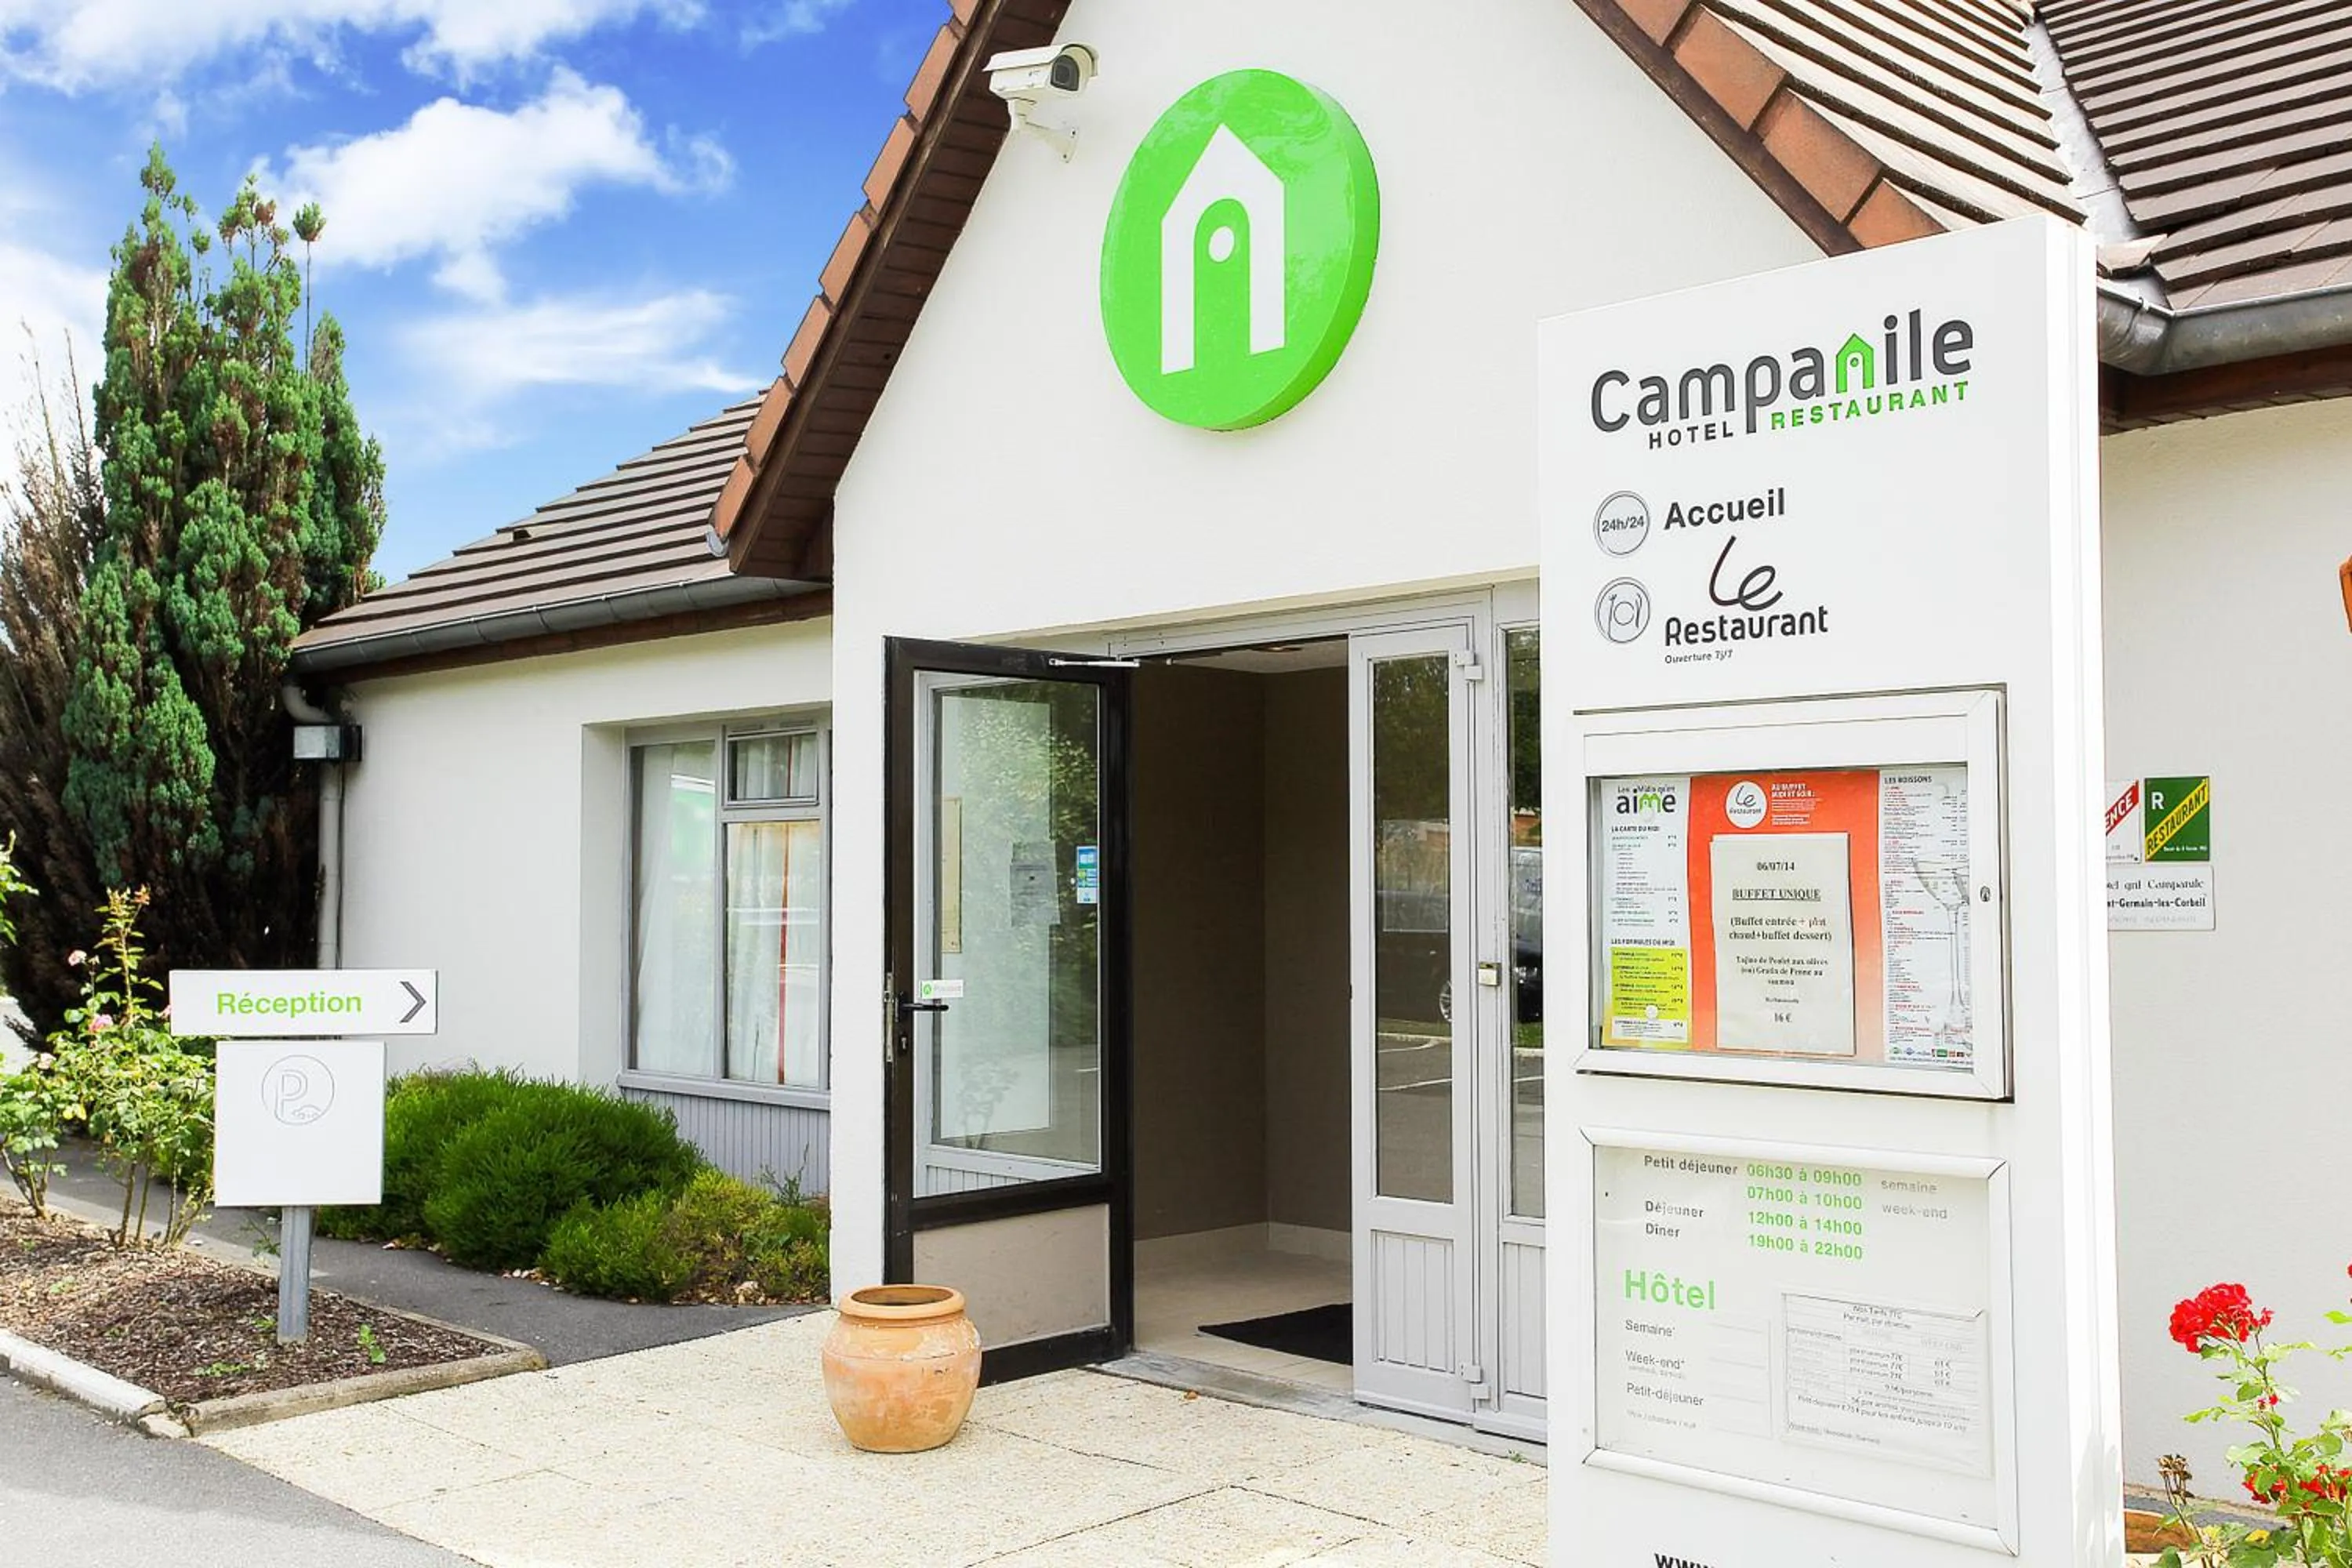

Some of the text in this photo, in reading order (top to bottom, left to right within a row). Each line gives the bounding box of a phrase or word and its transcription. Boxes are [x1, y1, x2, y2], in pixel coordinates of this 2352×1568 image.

[1591, 309, 1973, 434] Campanile
[1649, 382, 1969, 449] HOTEL RESTAURANT
[1664, 487, 1784, 530] Accueil
[1602, 514, 1645, 532] 24h/24
[1709, 535, 1783, 612] Le
[1665, 605, 1828, 646] Restaurant
[1664, 653, 1711, 663] Ouverture
[1616, 788, 1676, 814] aime
[2152, 792, 2164, 809] R
[2147, 784, 2207, 854] RESTAURANT
[1756, 862, 1795, 871] 06/07/14
[1733, 889, 1820, 900] BUFFET UNIQUE
[1730, 916, 1763, 926] (Buffet
[1793, 931, 1831, 941] dessert)
[216, 990, 362, 1018] Réception
[1644, 1155, 1937, 1194] Petit déjeuner 06h30 à 09h00 semaine
[1748, 1186, 1947, 1219] 07h00 à 10h00 week-end
[1646, 1200, 1862, 1235] Déjeuner 12h00 à 14h00
[1749, 1235, 1794, 1250] 19h00
[1800, 1240, 1808, 1252] à
[1815, 1242, 1862, 1258] 22h00
[1625, 1269, 1715, 1309] Hôtel
[1627, 1382, 1704, 1406] Petit-déjeuner
